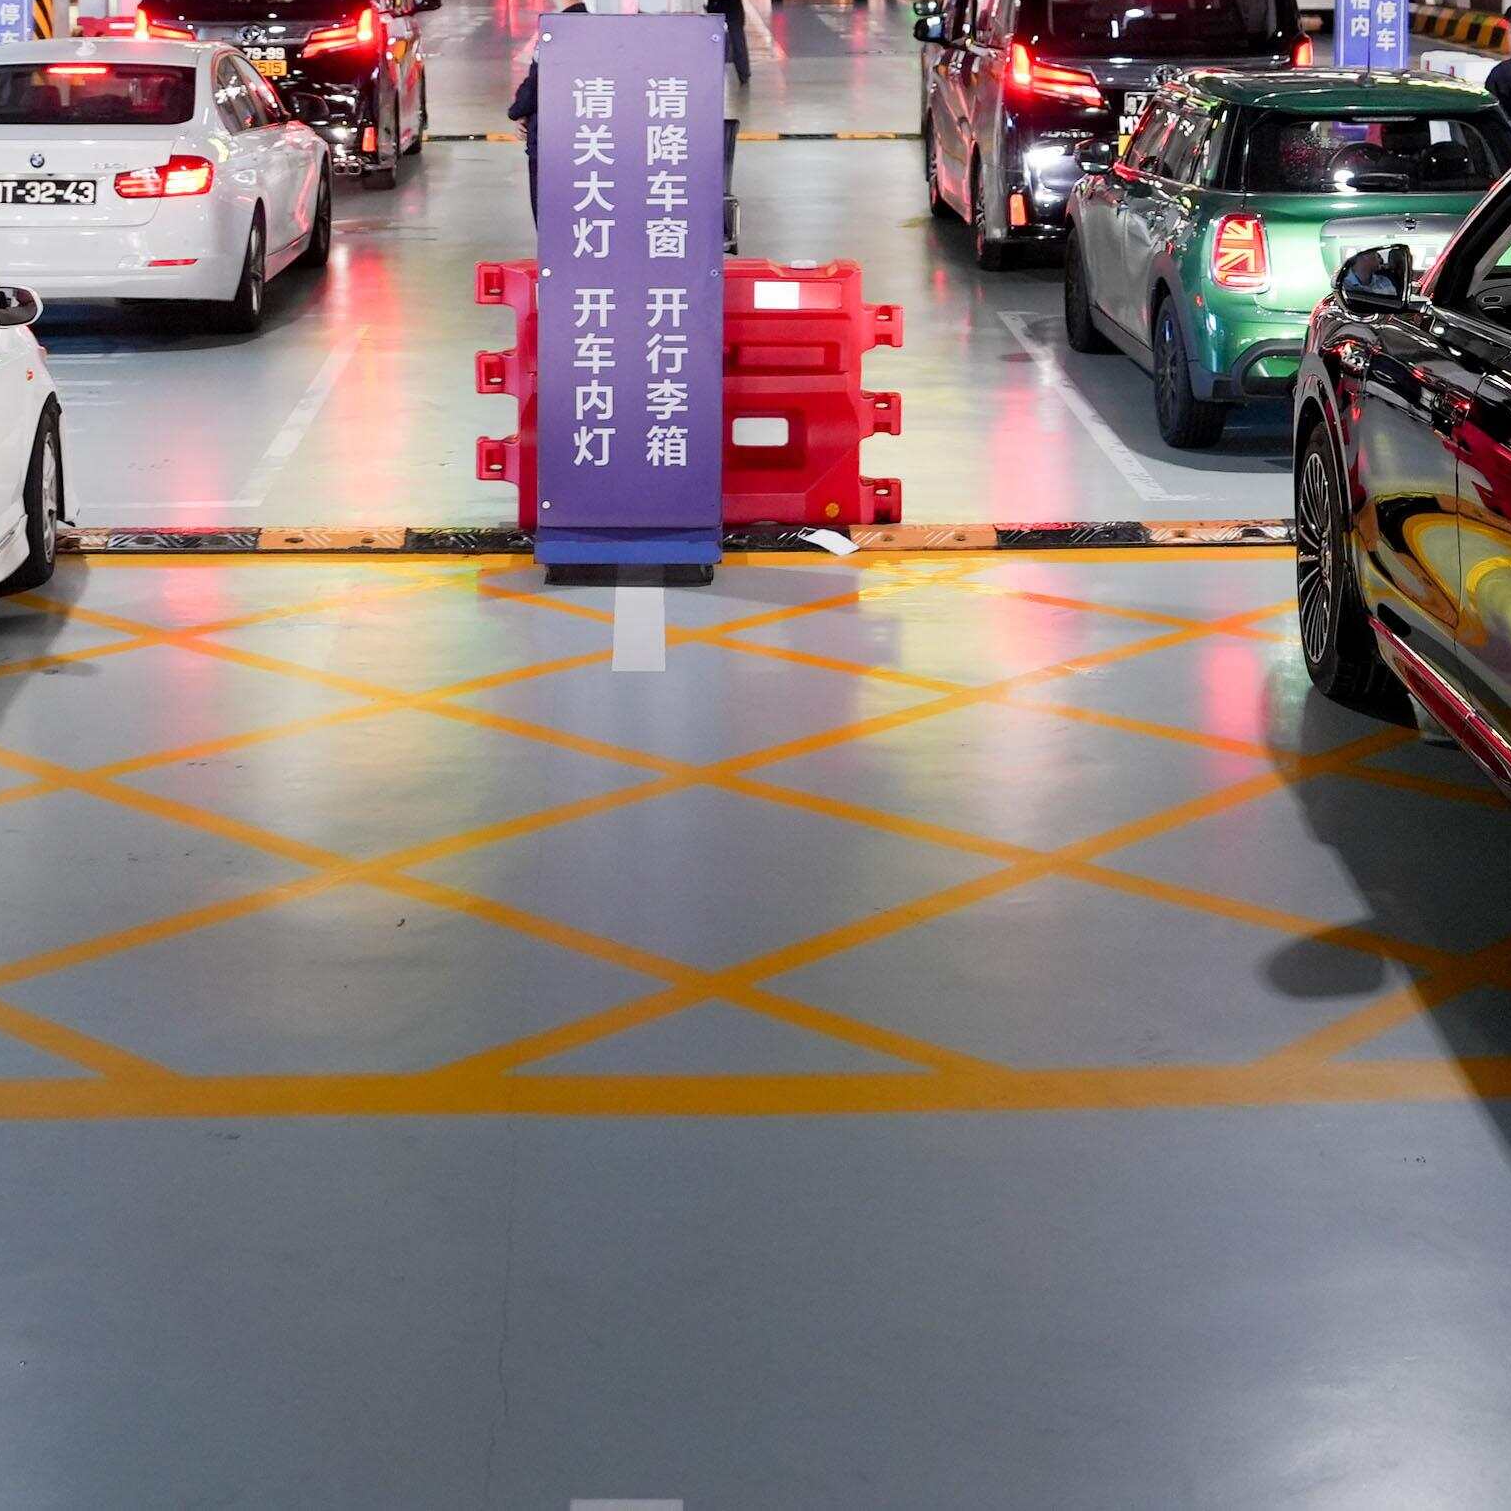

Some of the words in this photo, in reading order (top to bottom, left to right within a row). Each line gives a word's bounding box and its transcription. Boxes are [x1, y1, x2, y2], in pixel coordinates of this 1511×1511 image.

[573, 77, 616, 260] 请关大灯
[646, 77, 689, 260] 请降车窗
[573, 287, 616, 467] 开车内灯
[646, 287, 689, 468] 开行李箱
